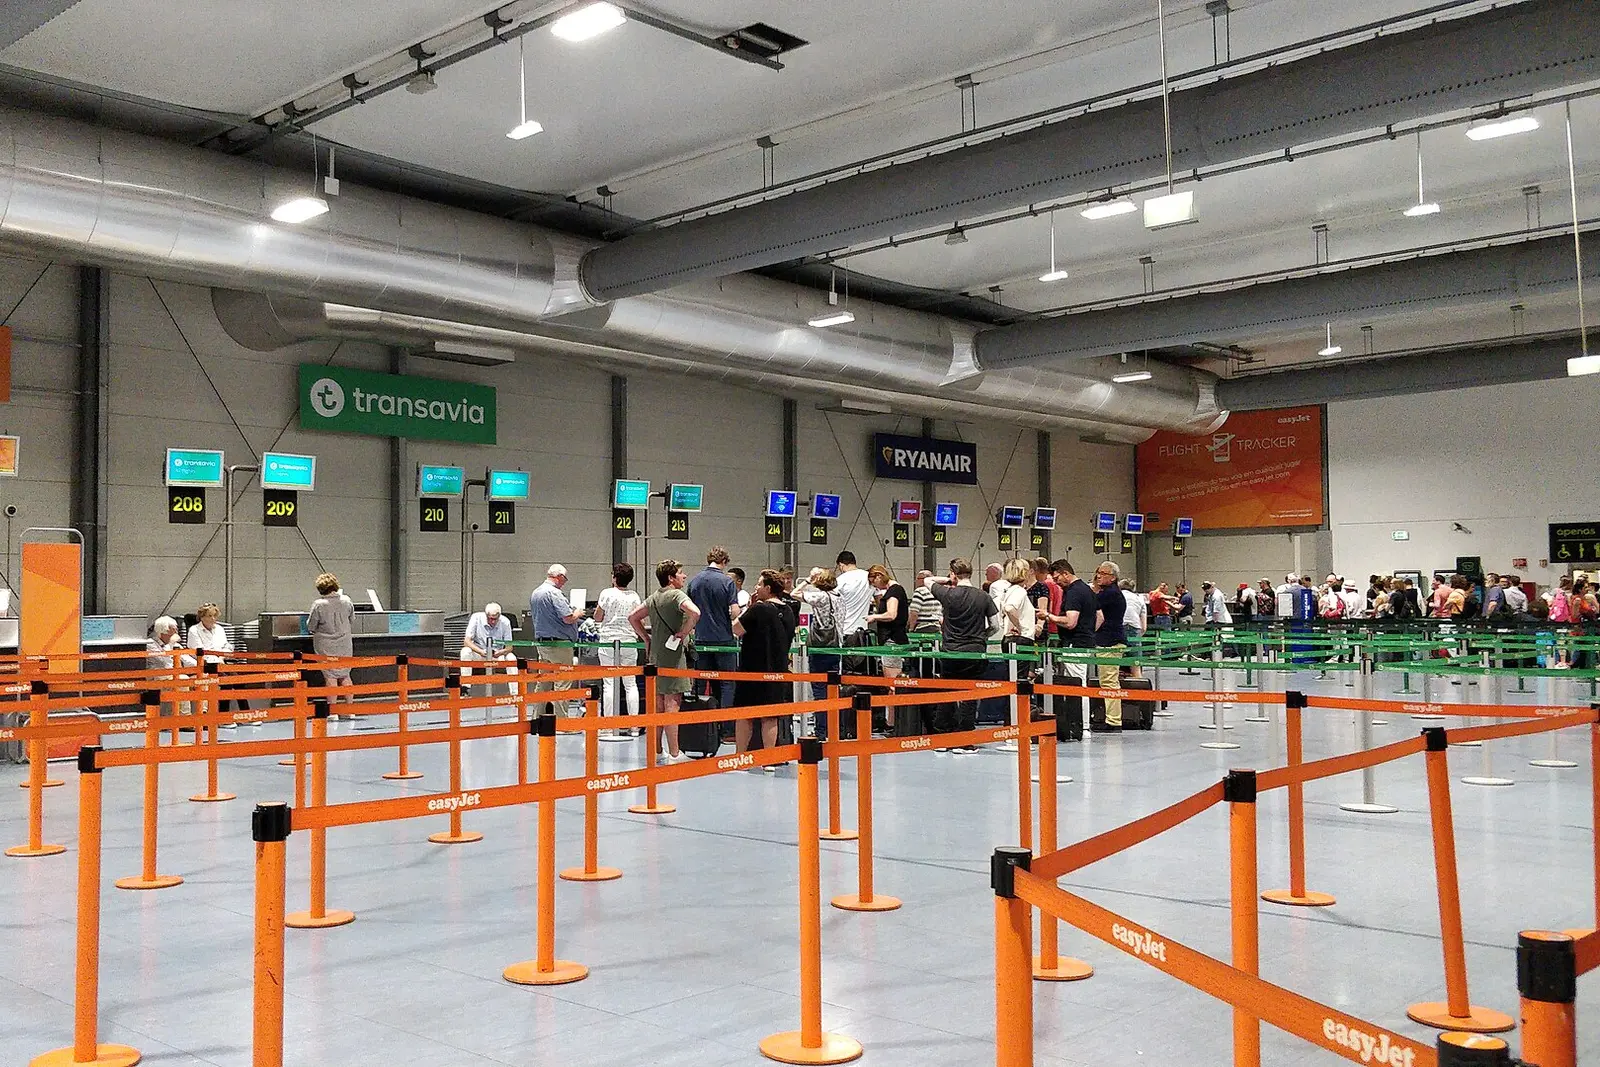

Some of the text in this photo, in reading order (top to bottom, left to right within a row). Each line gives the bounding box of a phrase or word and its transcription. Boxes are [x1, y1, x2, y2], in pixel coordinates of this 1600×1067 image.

[352, 387, 485, 425] transavia
[1277, 414, 1311, 424] easyJet
[1158, 435, 1296, 457] FLIGHT TRACKER
[894, 448, 972, 473] RYANAIR
[172, 496, 203, 512] 208
[266, 500, 295, 516] 209
[424, 508, 444, 522] 210
[495, 511, 510, 524] 211
[616, 517, 632, 529] 212
[671, 519, 686, 531] 213
[767, 524, 781, 535] 214
[813, 526, 825, 537] 215
[275, 671, 299, 680] easyJet
[699, 671, 720, 679] easyJet
[762, 673, 784, 681] easyJet
[107, 681, 136, 689] easyJet
[194, 677, 220, 686] easyJet
[893, 678, 919, 687] easyJet
[975, 681, 1002, 689] easyJet
[495, 694, 524, 705] easyJet
[1098, 689, 1129, 699] easyJet
[1204, 692, 1240, 701] easyJet
[399, 701, 431, 711] easyJet
[1402, 703, 1443, 714] easyJet
[232, 709, 268, 720] easyJet
[109, 719, 149, 731] easyJet
[993, 726, 1020, 739] easyJet
[900, 736, 931, 749] easyJet
[717, 753, 754, 770] easyJet
[586, 773, 630, 791] easyJet
[427, 792, 481, 812] easyJet
[1111, 921, 1167, 963] easyJet
[1321, 1016, 1416, 1067] easyJet
